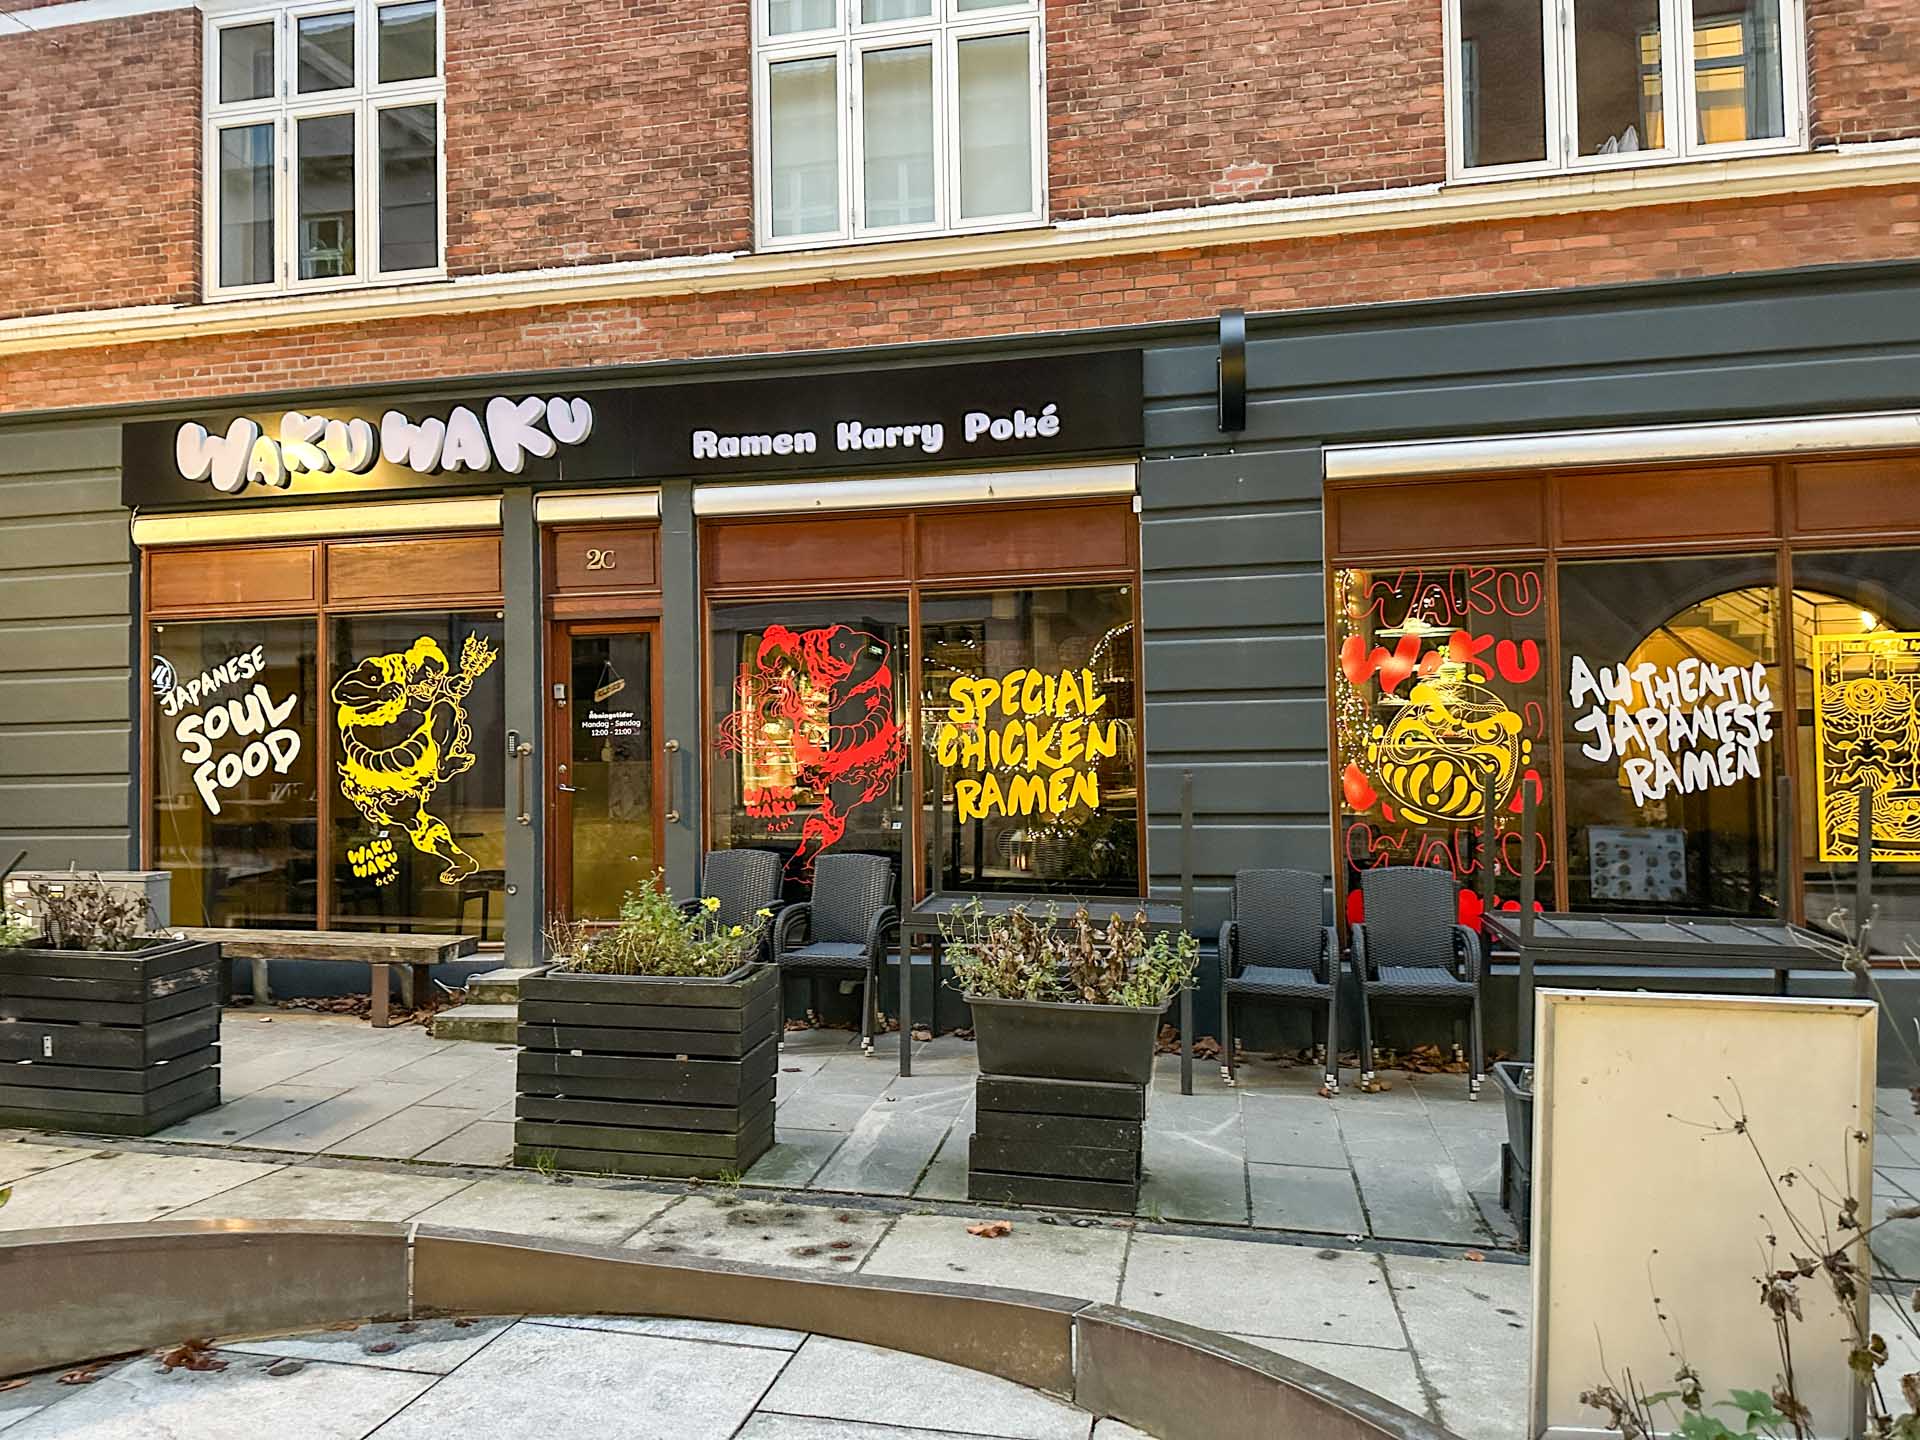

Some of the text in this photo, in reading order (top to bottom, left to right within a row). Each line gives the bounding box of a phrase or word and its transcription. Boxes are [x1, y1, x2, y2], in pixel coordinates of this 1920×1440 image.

[176, 396, 593, 493] WAKU WAKU
[693, 403, 1060, 459] Ramen Karry Poké
[586, 549, 616, 570] 2C
[1343, 564, 1541, 629] WAKU
[160, 645, 265, 716] JAPANESE
[948, 668, 1106, 726] SPECIAL
[1570, 655, 1770, 708] AUTHENTIC
[175, 684, 297, 764] SOUL
[588, 710, 634, 720] Åbningstider
[591, 729, 609, 737] 12:00
[614, 728, 632, 736] 21:00
[1574, 700, 1774, 762] JAPANESE
[193, 729, 300, 815] FOOD
[938, 717, 1117, 772] CHICKEN
[955, 767, 1099, 824] RAMEN
[1623, 743, 1760, 807] RAMEN
[347, 838, 393, 864] WAKU
[352, 851, 398, 878] WAKU
